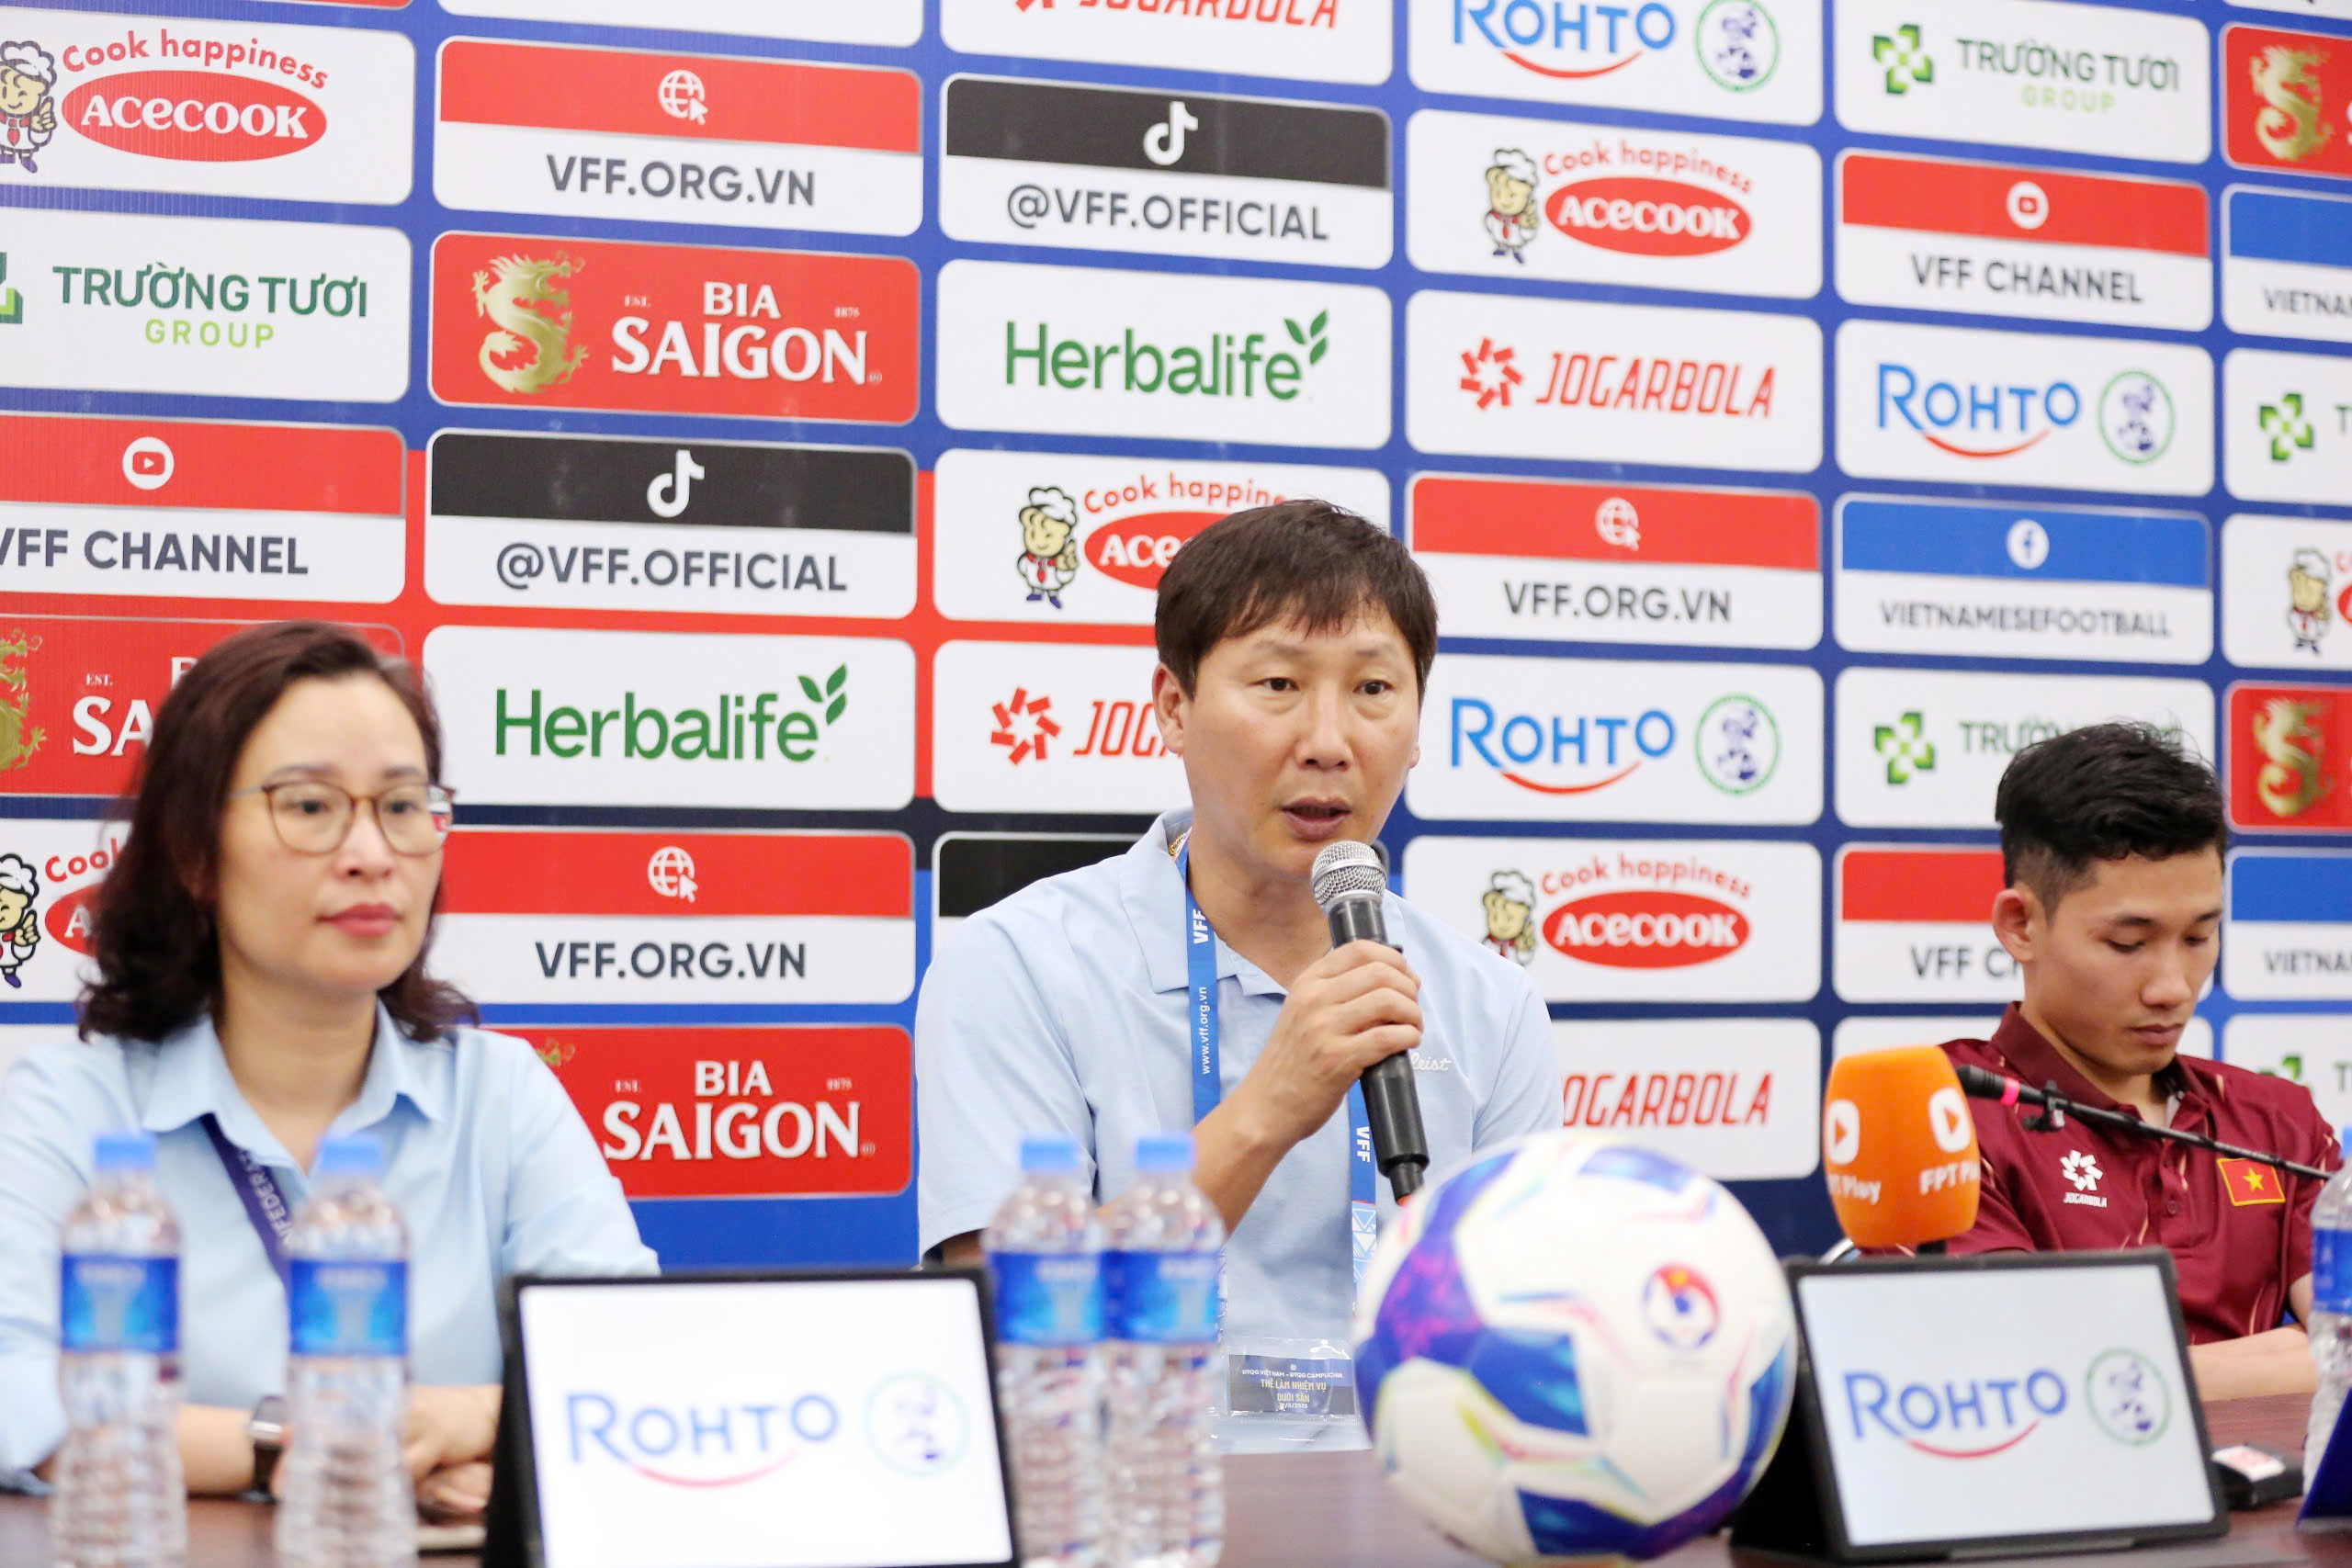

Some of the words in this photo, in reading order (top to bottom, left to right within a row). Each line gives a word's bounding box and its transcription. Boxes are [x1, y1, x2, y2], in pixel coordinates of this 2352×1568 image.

[1453, 0, 1676, 52] ROHTO
[63, 30, 150, 73] Cook
[161, 28, 329, 90] happiness
[1956, 39, 2096, 84] TRƯỜNG
[2102, 54, 2179, 90] TƯƠI
[2021, 85, 2117, 113] GROUP
[547, 154, 815, 207] VFF.ORG.VN
[1544, 141, 1611, 176] Cook
[1621, 141, 1753, 195] happiness
[1007, 184, 1329, 241] @VFF.OFFICIAL
[52, 263, 250, 312] TRƯỜNG
[259, 273, 368, 318] TƯƠI
[703, 282, 781, 319] BIA
[1911, 254, 1972, 289] VFF
[1986, 261, 2143, 303] CHANNEL
[144, 319, 274, 349] GROUP
[612, 316, 867, 385] SAIGON
[1006, 321, 1304, 400] Herbalife
[1535, 352, 1776, 418] JOGARBOLA
[1878, 363, 2081, 433] ROHTO
[1085, 474, 1158, 513] Cook
[85, 530, 309, 575] CHANNEL
[497, 543, 847, 591] @VFF.OFFICIAL
[1503, 581, 1731, 622] VFF.ORG.VN
[1880, 602, 2172, 638] VIETNAMESEFOOTBALL
[495, 689, 819, 762] Herbalife
[1452, 697, 1677, 768] ROHTO
[1541, 853, 1610, 896] Cook
[1619, 852, 1751, 899] happiness
[1193, 908, 1207, 944] VFF
[535, 942, 807, 979] VFF.ORG.VN
[1910, 946, 1972, 978] VFF
[1198, 987, 1212, 1075] www.vff.org.vn
[695, 1060, 773, 1097] BIA
[1410, 1053, 1453, 1071] leist
[1564, 1073, 1773, 1128] OGARBOLA
[603, 1100, 861, 1160] SAIGON
[1355, 1125, 1372, 1163] VFF
[1919, 1163, 1958, 1196] FPT
[565, 1392, 841, 1464] ROHTO
[1844, 1369, 2069, 1441] ROHTO
